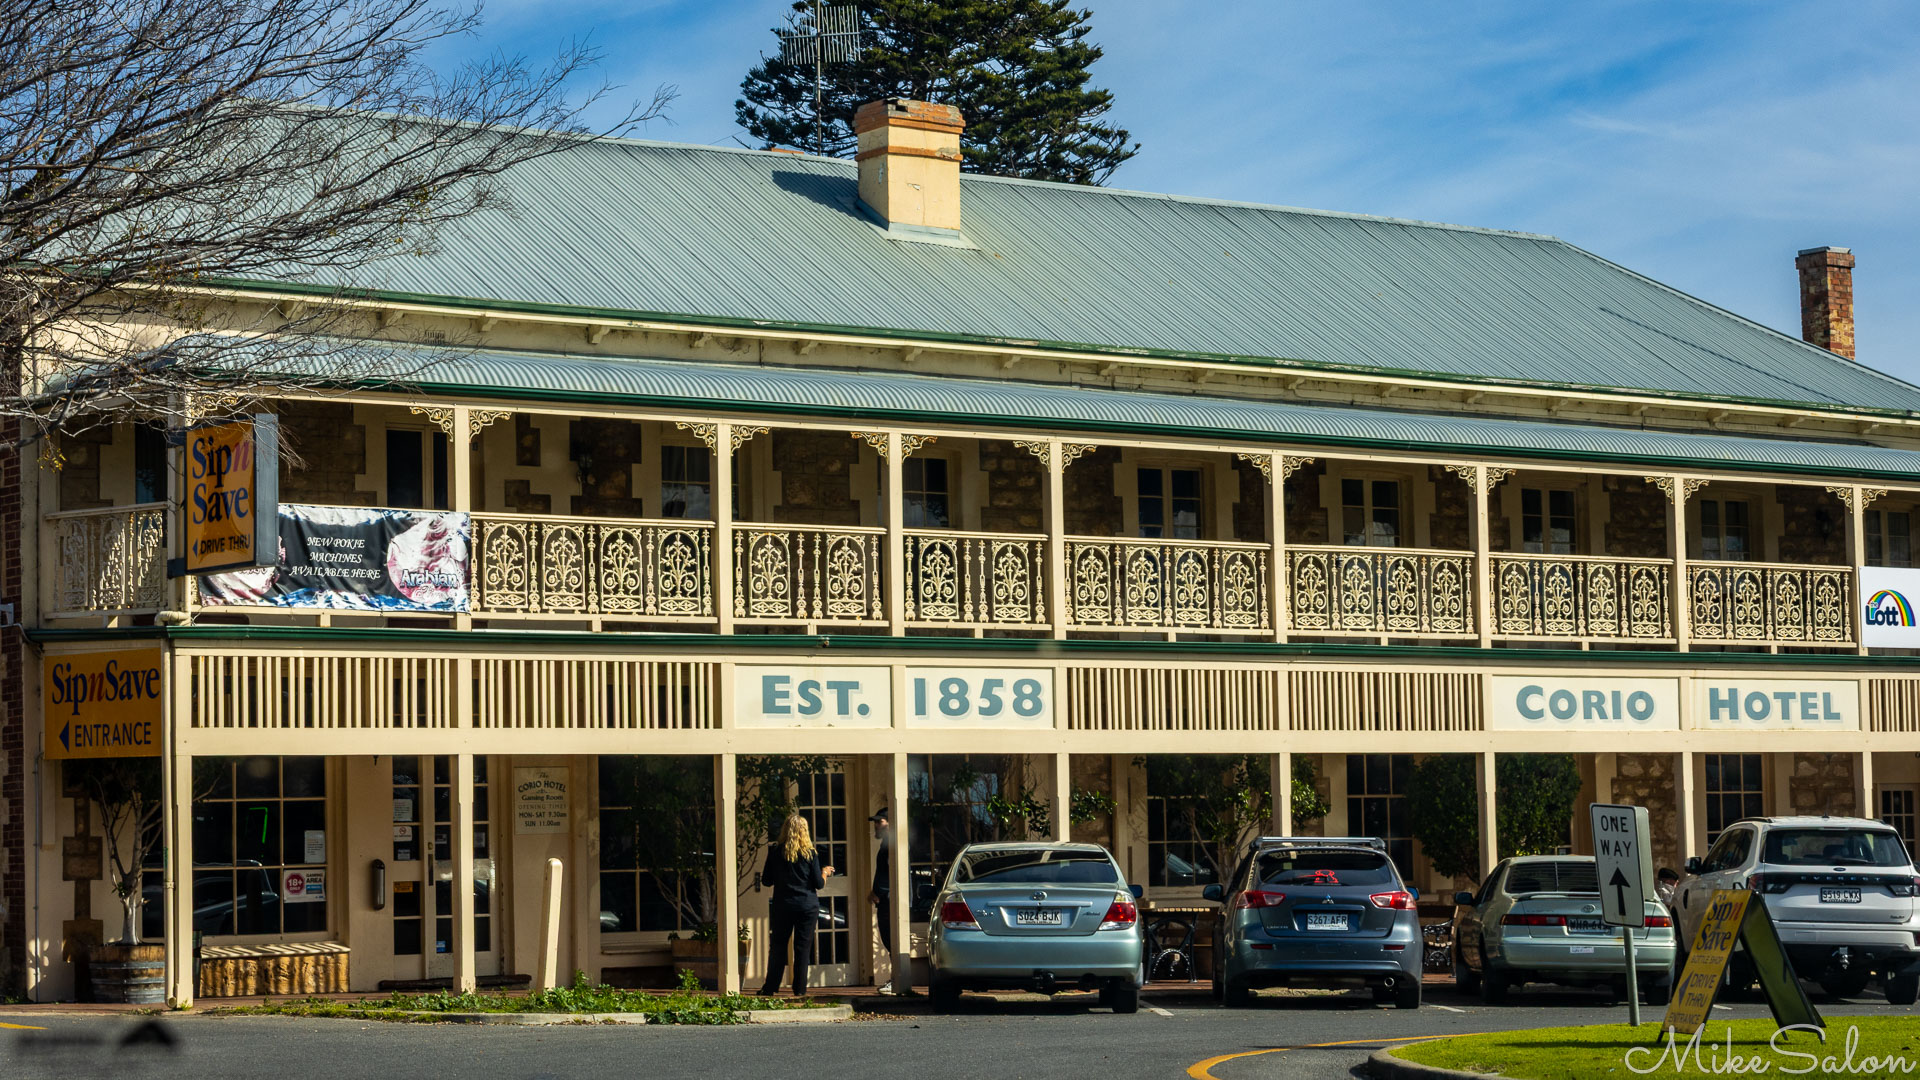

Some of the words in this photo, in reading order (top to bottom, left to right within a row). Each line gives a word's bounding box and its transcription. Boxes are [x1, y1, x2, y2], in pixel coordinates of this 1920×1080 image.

[192, 436, 250, 488] Sipn
[193, 483, 249, 525] Save
[200, 537, 225, 554] DRIVE
[228, 534, 250, 550] THRU
[307, 536, 333, 547] NEW
[333, 538, 366, 549] POKIE
[310, 552, 363, 564] MACHINES
[289, 565, 350, 578] AVAILABLE
[351, 568, 381, 579] HERE
[400, 568, 458, 588] Arabian
[1865, 605, 1899, 626] Lott
[762, 675, 870, 716] EST.
[914, 677, 1043, 717] 1858
[1516, 685, 1655, 721] CORIO
[1708, 688, 1841, 721] HOTEL
[75, 722, 152, 747] ENTRANCE
[518, 780, 542, 793] CORIO
[543, 780, 567, 793] HOTEL
[1600, 815, 1629, 833] ONE
[1600, 839, 1632, 857] WAY
[288, 878, 303, 887] 18+
[1707, 894, 1743, 928] Sipn
[1696, 924, 1732, 951] Save
[1690, 974, 1718, 989] DRIVE
[1685, 992, 1709, 1008] THRU
[1668, 1012, 1702, 1025] ENTRANCE
